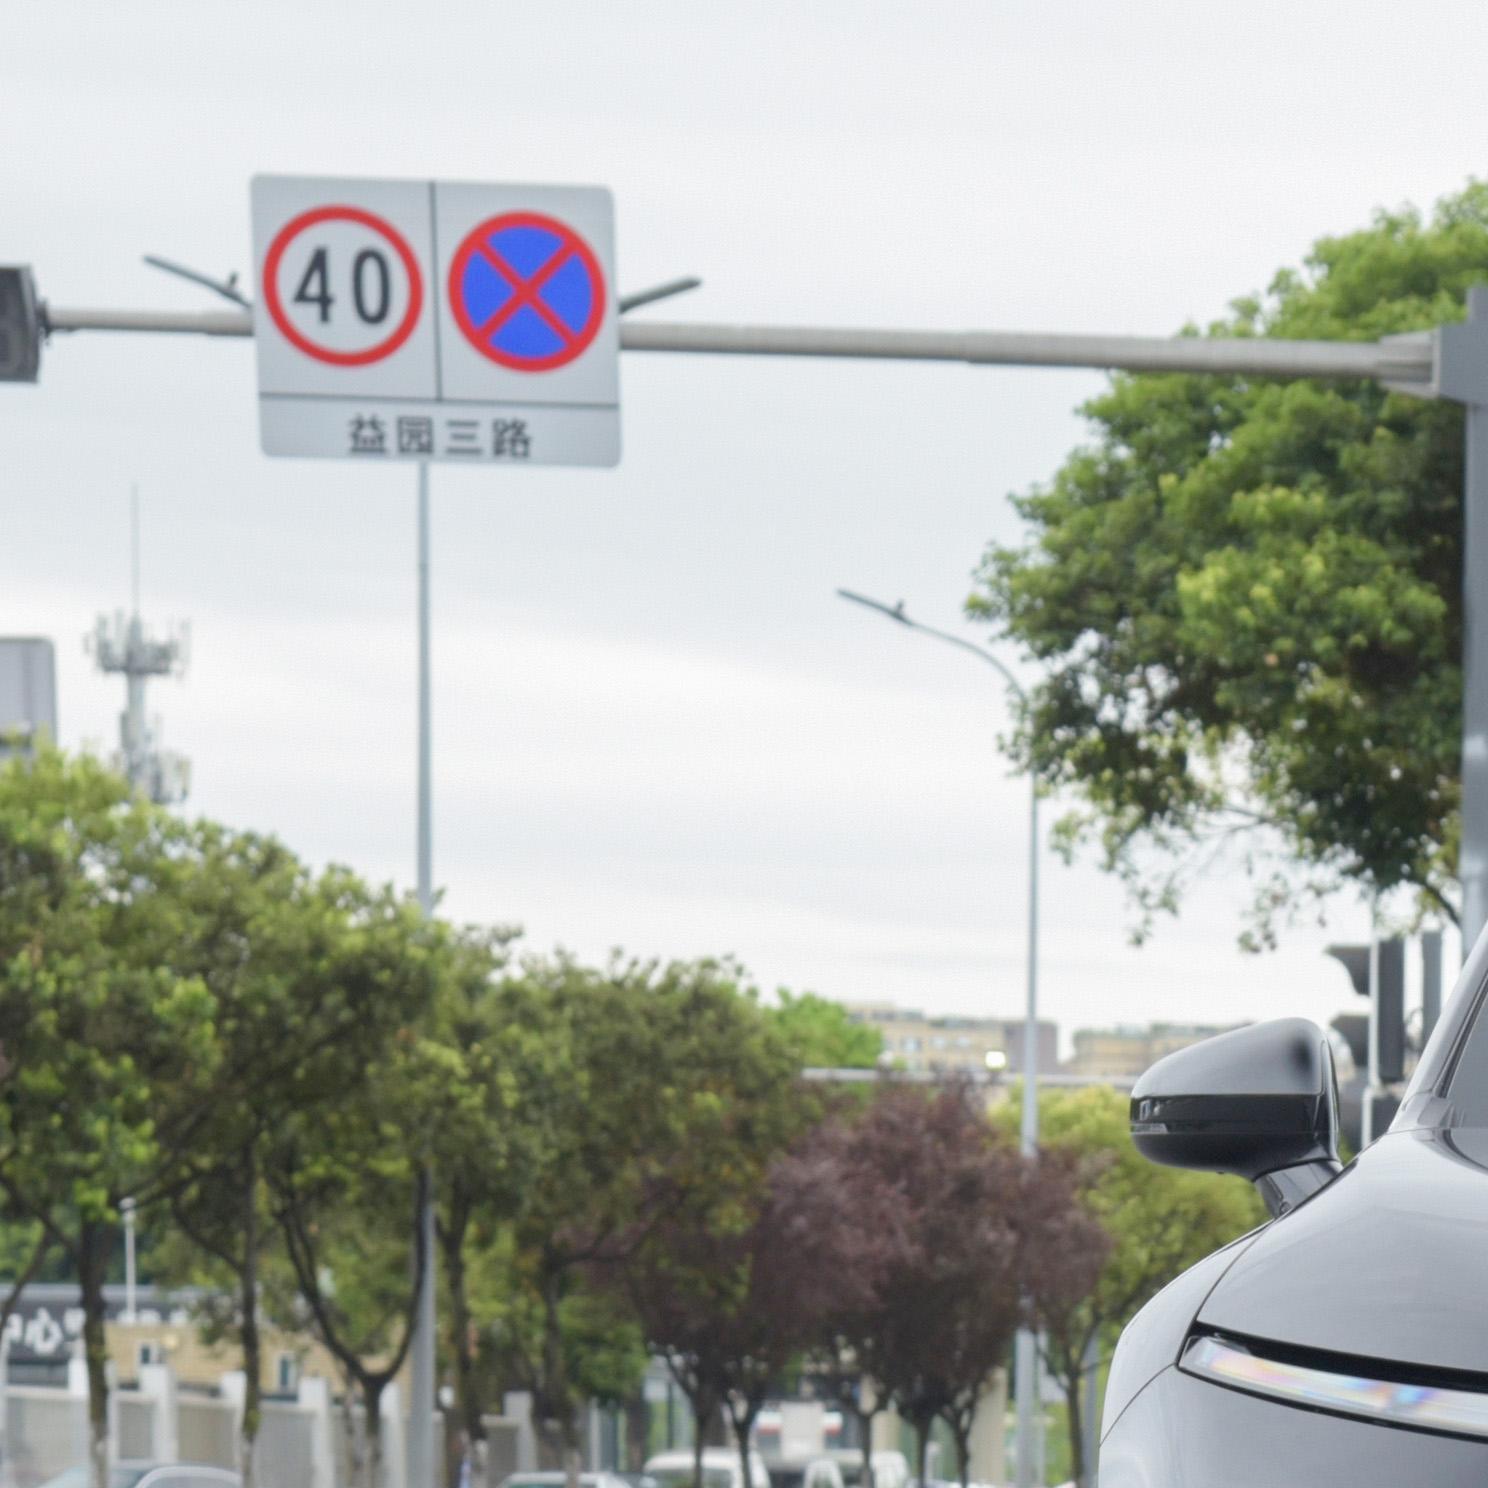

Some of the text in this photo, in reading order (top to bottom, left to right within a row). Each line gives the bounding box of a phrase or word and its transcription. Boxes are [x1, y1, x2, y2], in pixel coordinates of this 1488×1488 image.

[294, 245, 391, 325] 40
[348, 415, 532, 458] 益园三路
